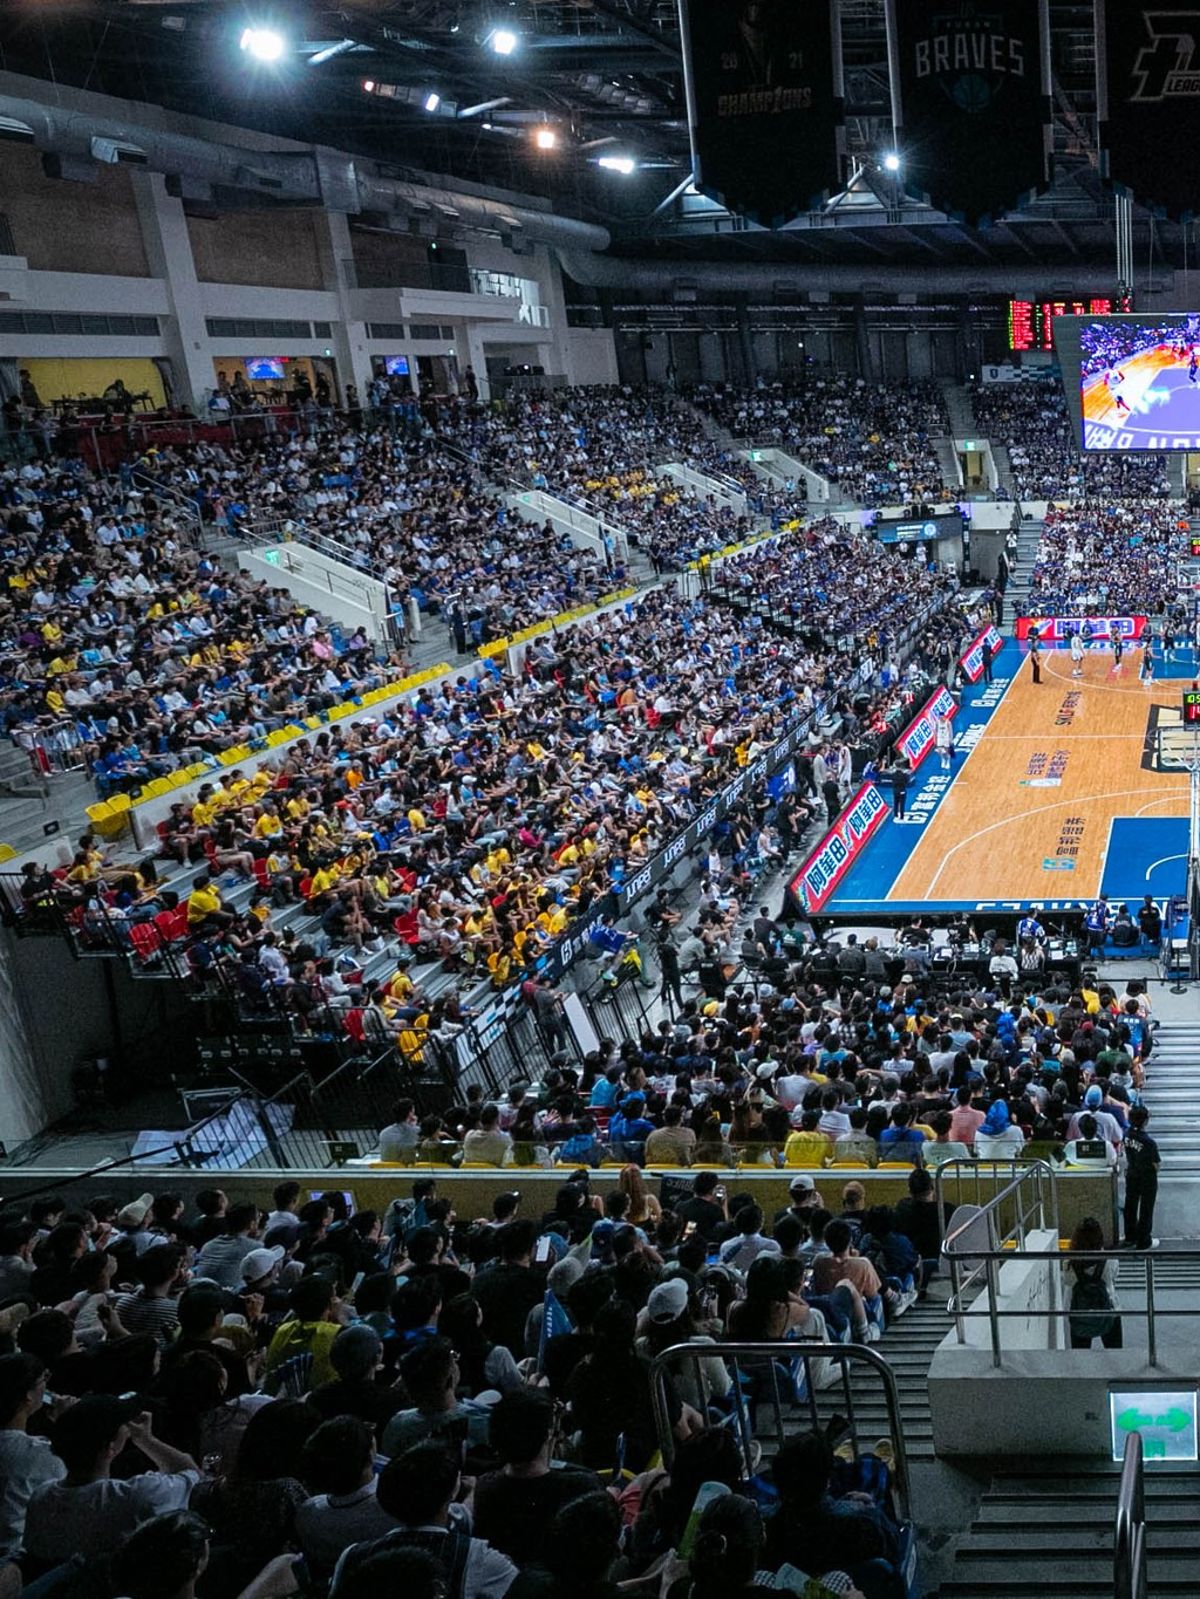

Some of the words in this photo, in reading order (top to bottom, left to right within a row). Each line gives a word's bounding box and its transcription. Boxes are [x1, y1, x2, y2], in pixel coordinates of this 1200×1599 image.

[914, 33, 1025, 79] BRAVES
[848, 786, 884, 839] 阿華田
[804, 835, 848, 897] 阿華田
